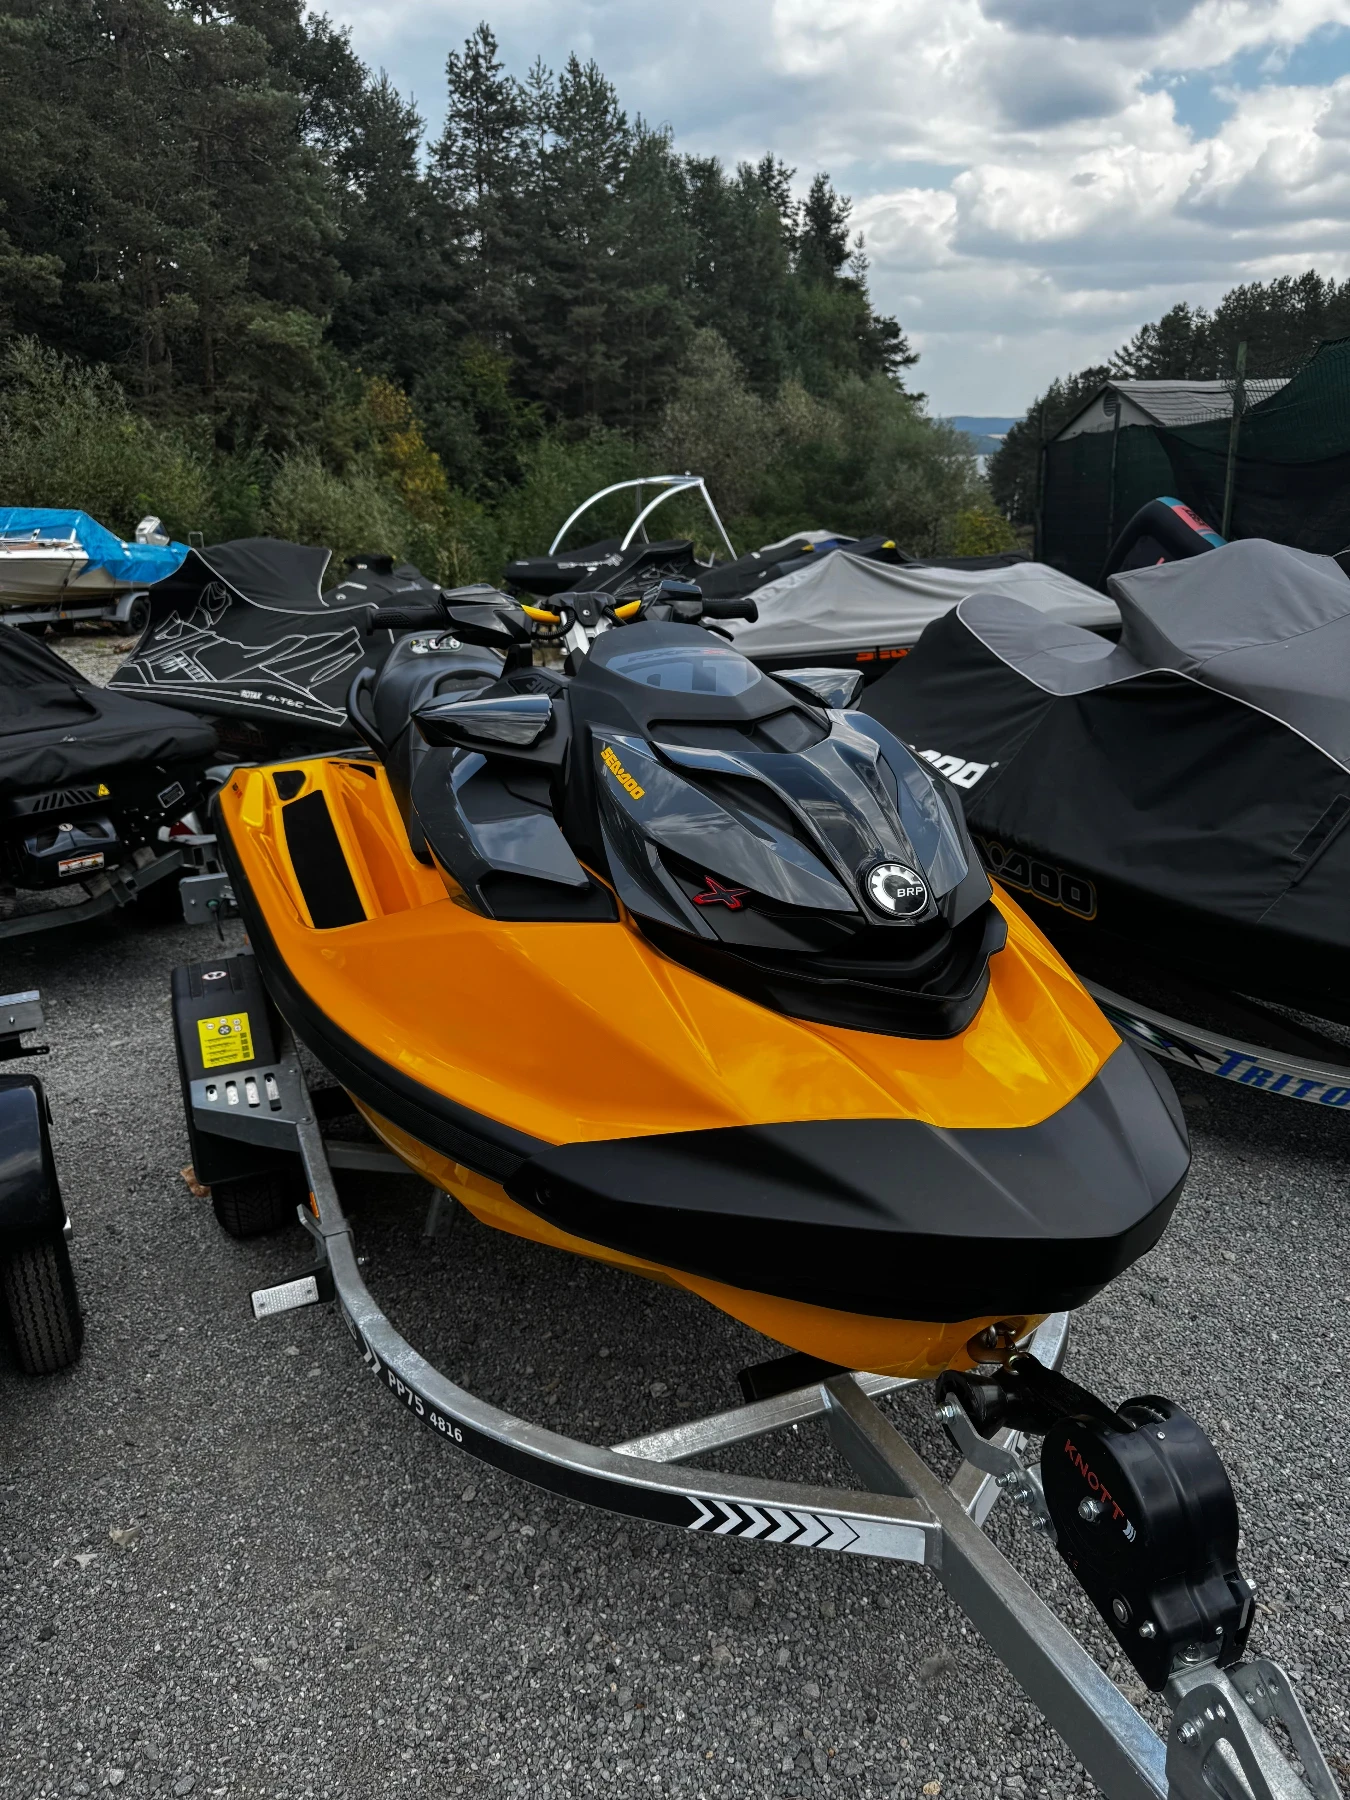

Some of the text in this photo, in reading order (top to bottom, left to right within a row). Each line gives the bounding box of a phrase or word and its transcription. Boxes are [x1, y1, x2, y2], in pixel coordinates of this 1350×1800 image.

[240, 689, 262, 700] ROTAX
[897, 886, 924, 898] BRP
[387, 1369, 464, 1443] PP75 4816
[1064, 1438, 1126, 1521] KNOTT
